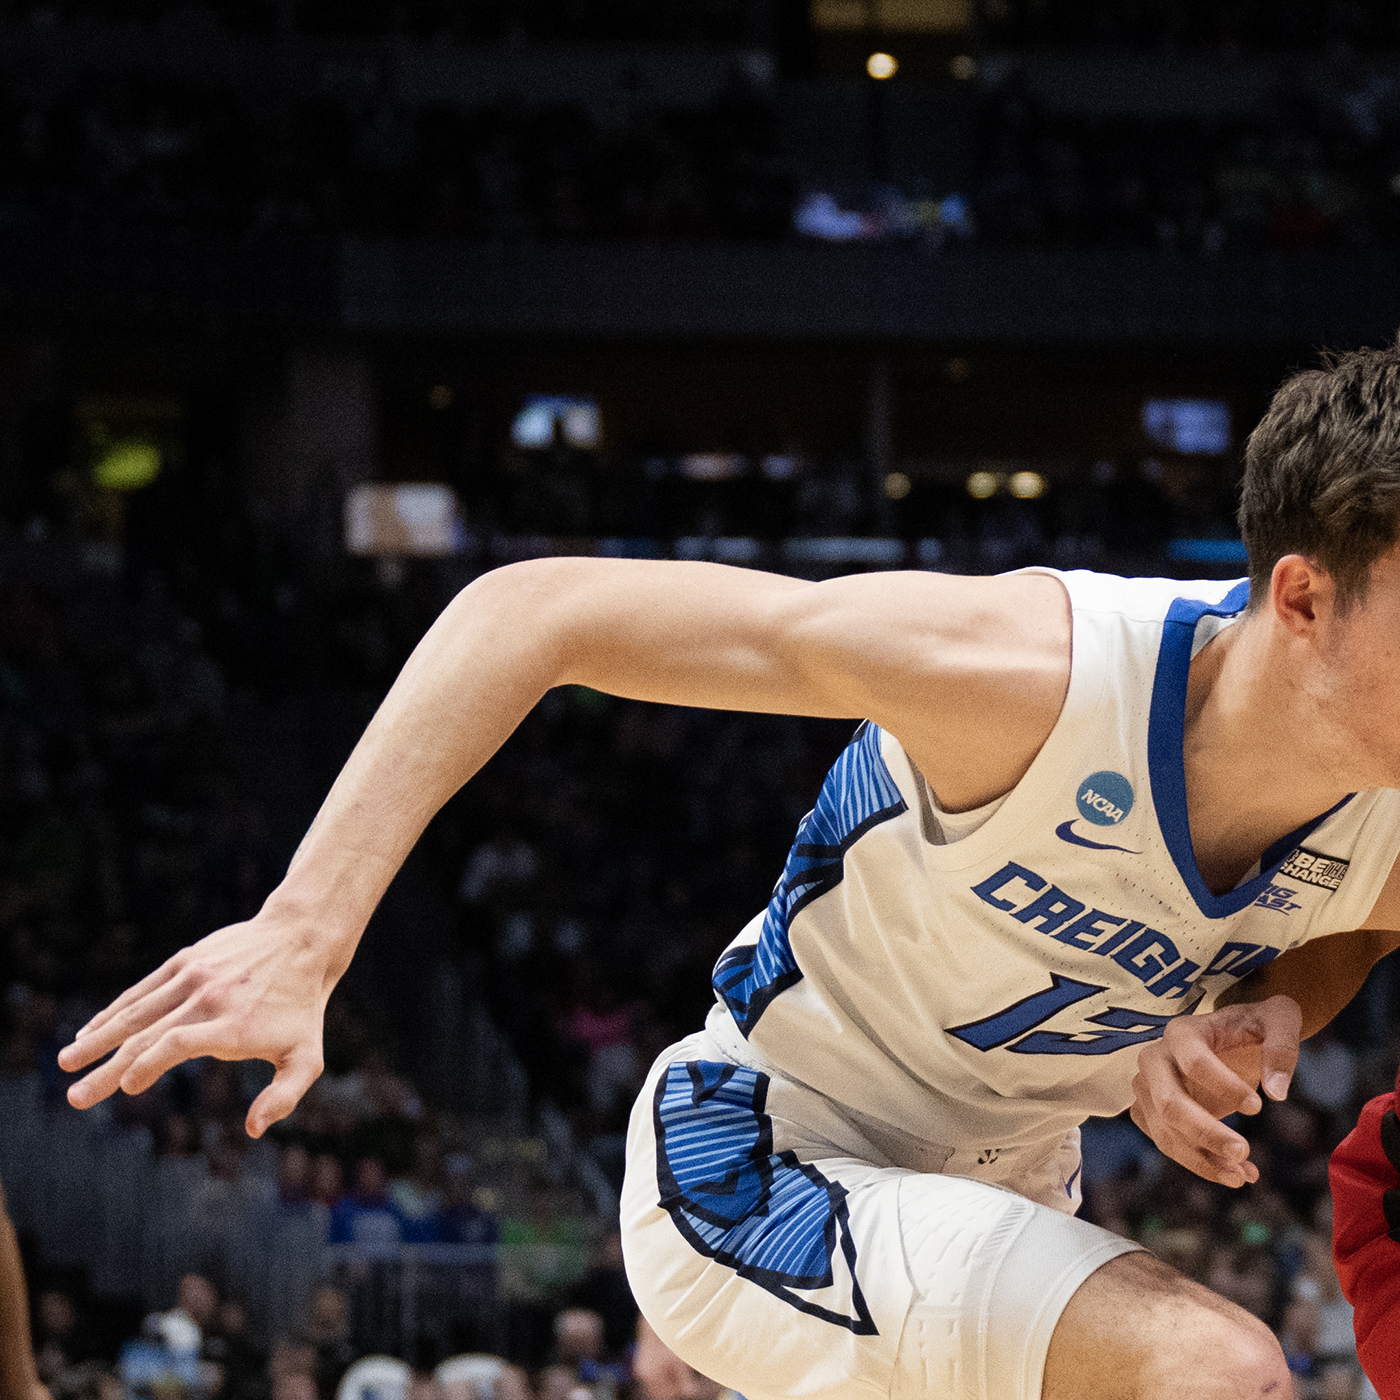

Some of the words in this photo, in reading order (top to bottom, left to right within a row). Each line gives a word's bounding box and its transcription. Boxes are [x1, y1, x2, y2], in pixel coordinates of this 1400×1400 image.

[1081, 788, 1124, 822] NCAA
[1280, 862, 1341, 889] HANGE
[1254, 894, 1302, 911] AST
[1264, 885, 1299, 899] IG
[970, 861, 1282, 999] CREIGHO
